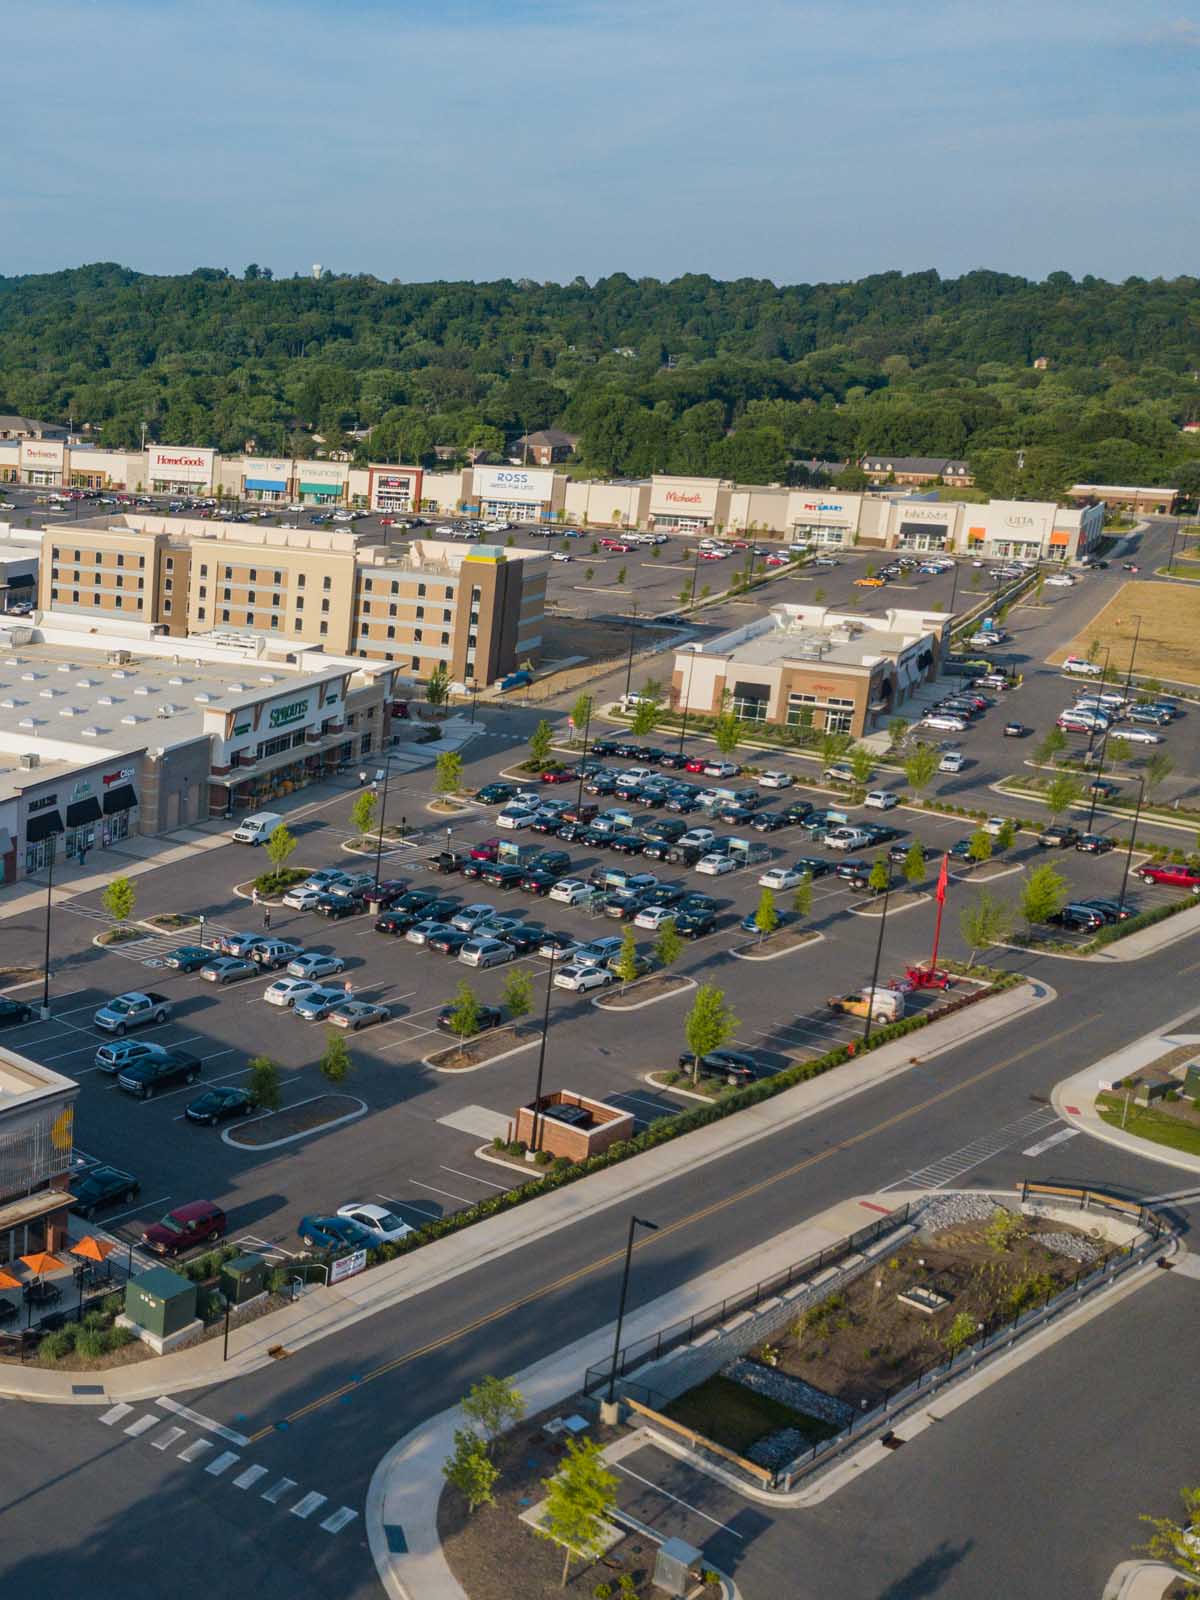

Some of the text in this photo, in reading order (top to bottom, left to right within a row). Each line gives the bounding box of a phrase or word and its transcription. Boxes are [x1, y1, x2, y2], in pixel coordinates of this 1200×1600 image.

[157, 454, 205, 467] HomeGoods
[497, 472, 528, 483] ROSS
[270, 700, 308, 722] SPROUTS
